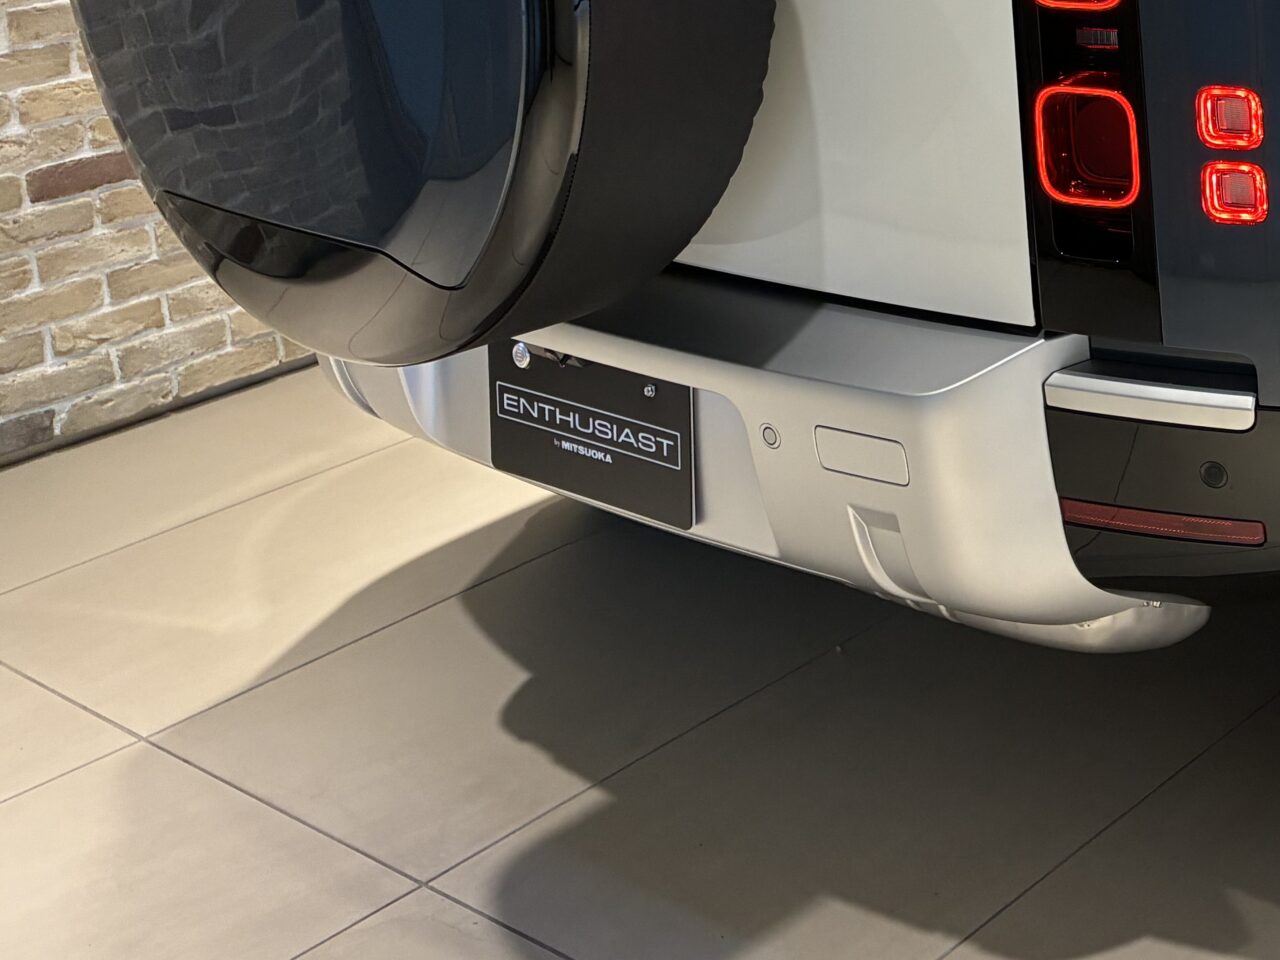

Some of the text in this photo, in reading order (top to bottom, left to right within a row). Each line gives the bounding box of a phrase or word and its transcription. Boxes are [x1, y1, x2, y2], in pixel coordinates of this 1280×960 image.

[503, 393, 674, 456] ENTHUSIAST
[553, 438, 613, 464] by MITSUOKA
